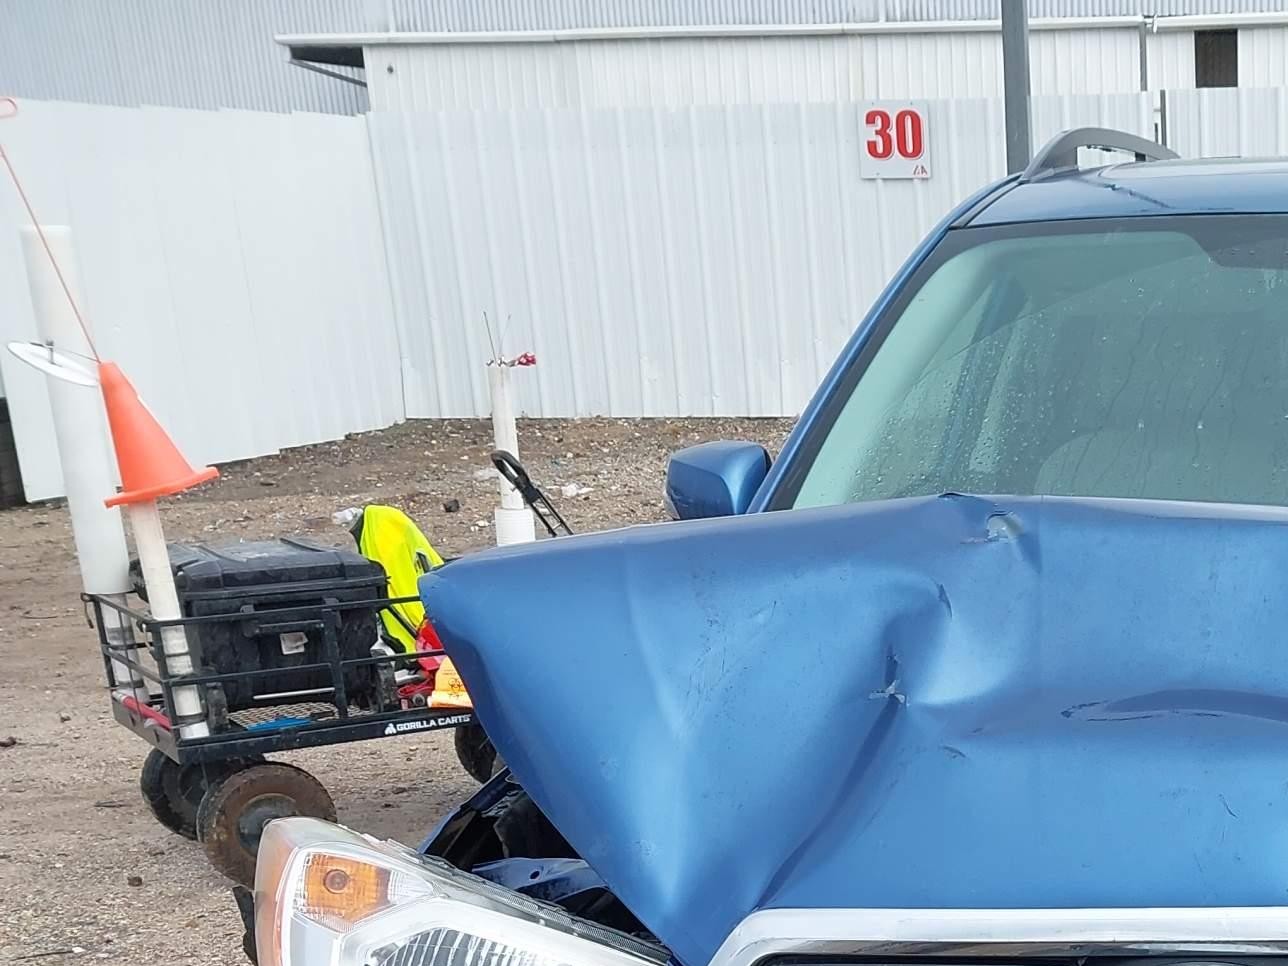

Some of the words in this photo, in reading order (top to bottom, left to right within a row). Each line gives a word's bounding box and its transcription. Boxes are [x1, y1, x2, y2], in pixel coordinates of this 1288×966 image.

[865, 109, 924, 159] 30
[396, 719, 437, 732] GORILLA
[437, 713, 472, 727] CARTS
